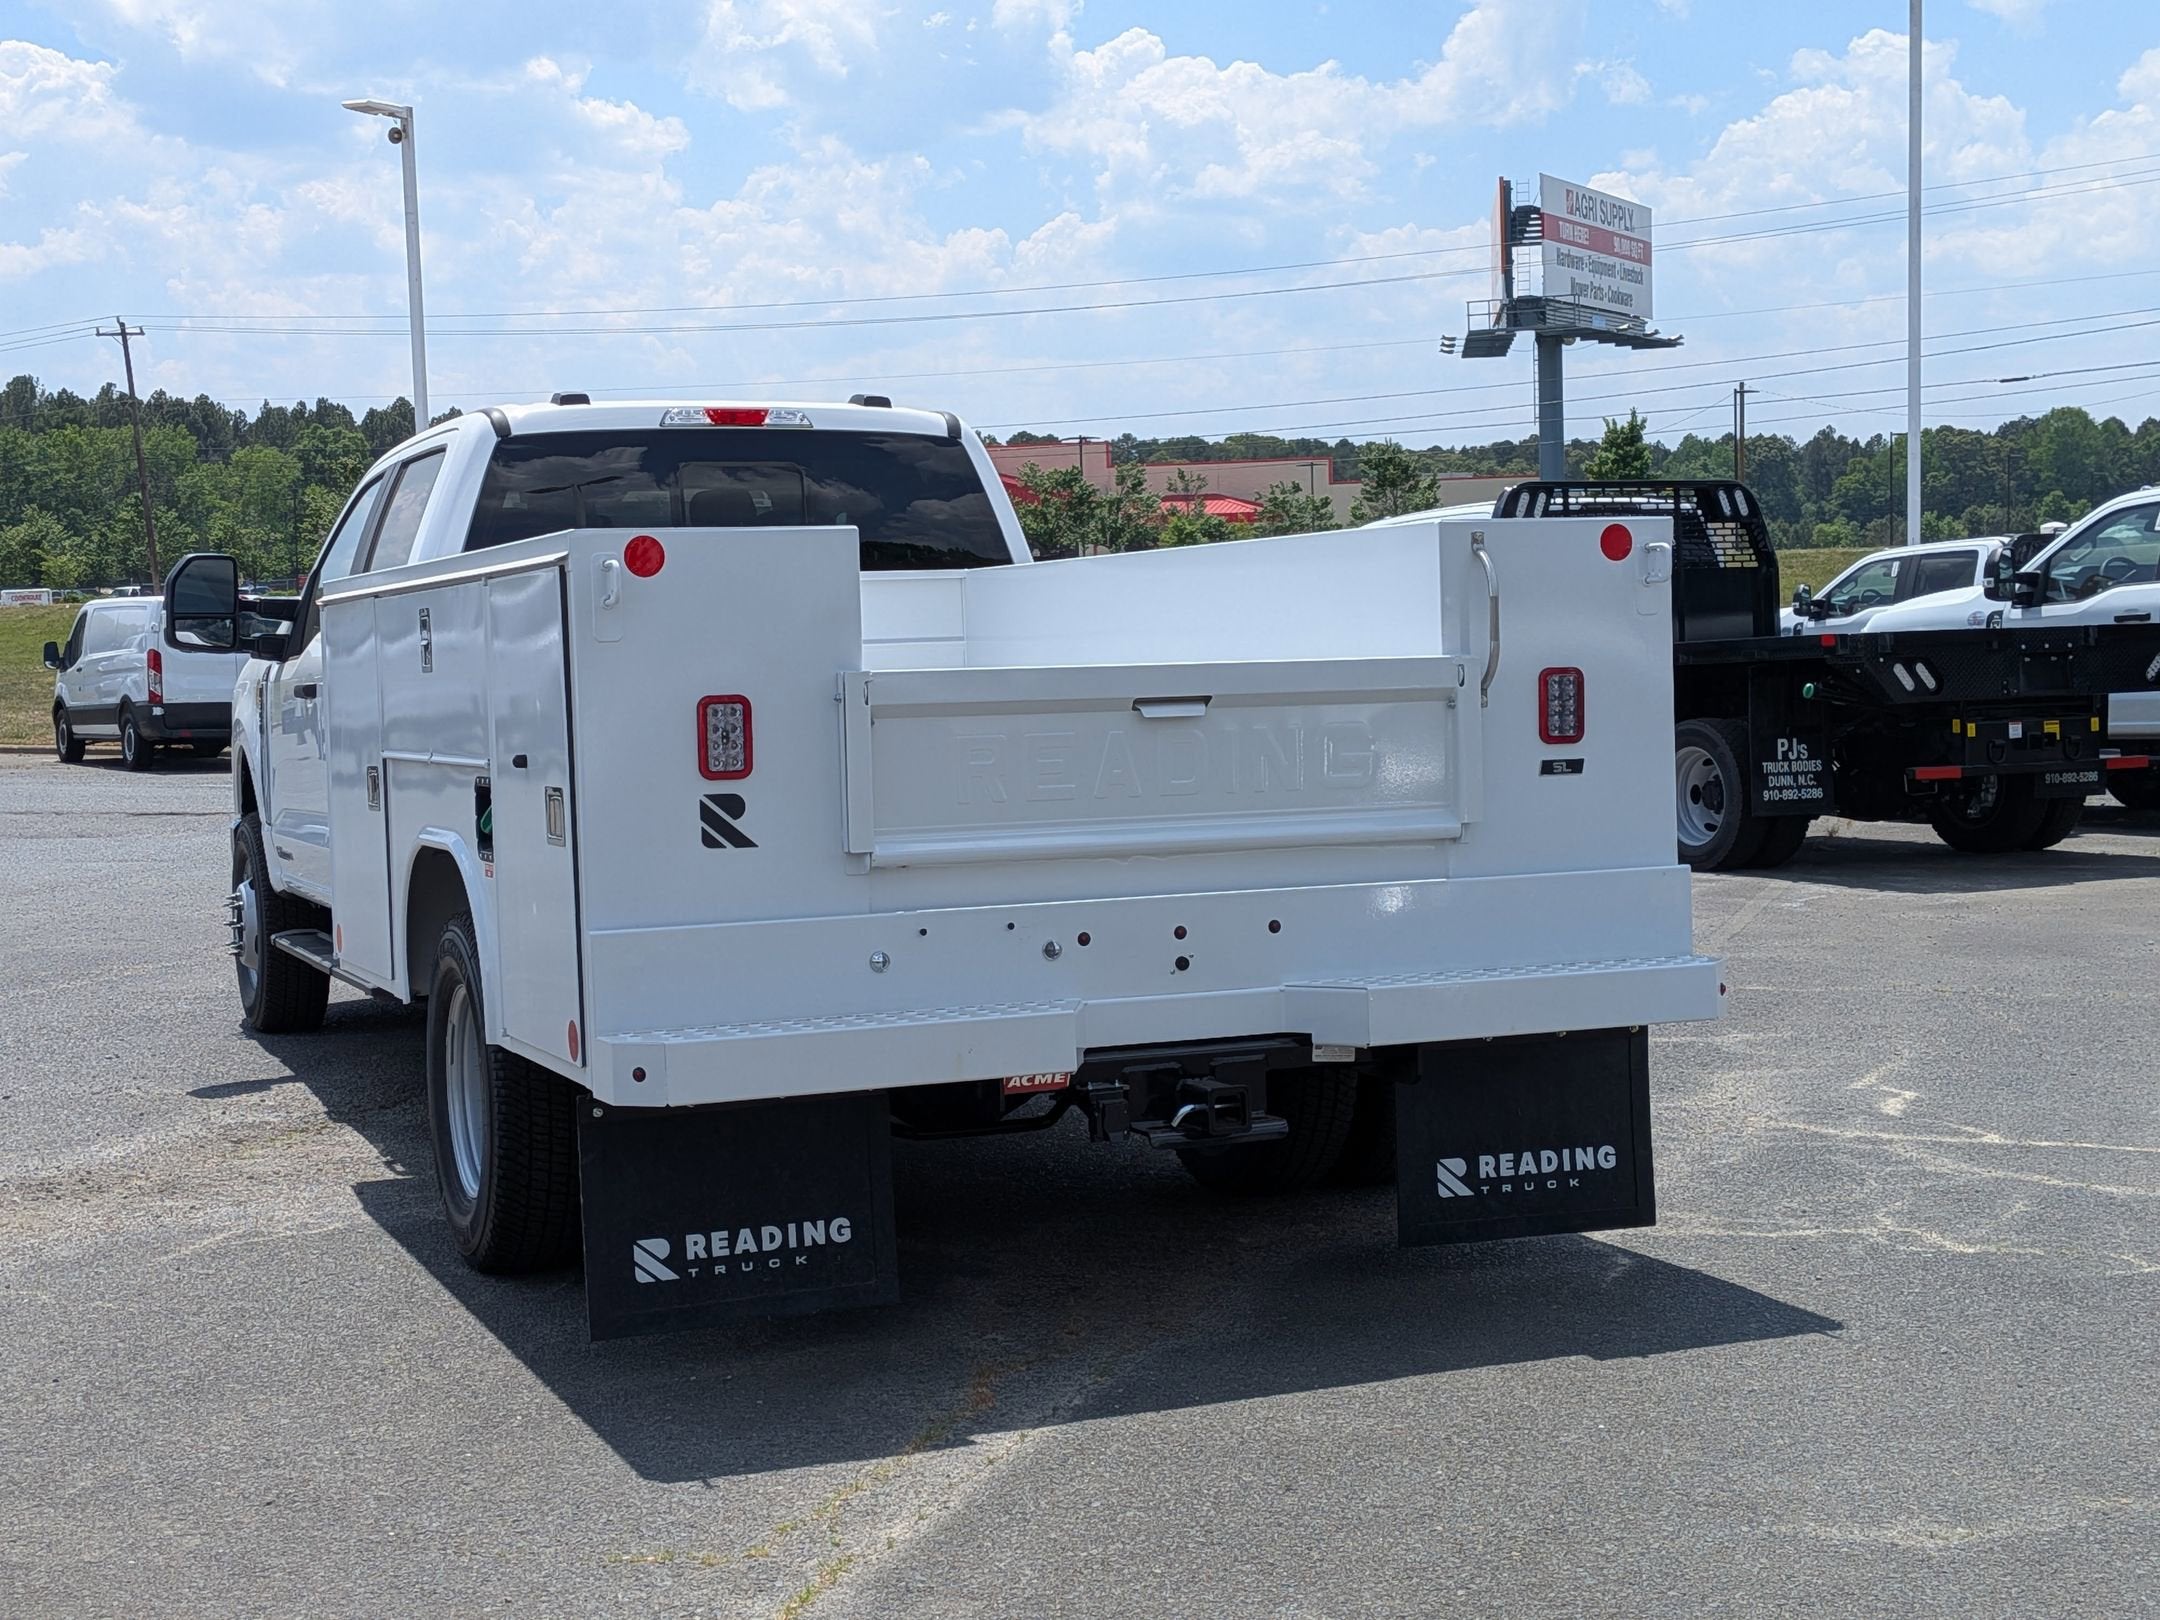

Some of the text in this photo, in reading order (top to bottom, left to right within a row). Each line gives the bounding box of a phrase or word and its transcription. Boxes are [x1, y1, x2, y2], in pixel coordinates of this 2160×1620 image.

[1574, 192, 1634, 232] AGRI SUPPLY
[953, 721, 1375, 805] READING
[1762, 759, 1823, 774] TRUCK BODIES
[1768, 775, 1797, 788] DUNN,
[2044, 770, 2099, 784] 910-892-5286
[1763, 787, 1824, 801] 910-892-5286
[1007, 1072, 1066, 1088] ACME
[1478, 1145, 1617, 1179] READING
[1480, 1178, 1580, 1194] TRUCK
[685, 1217, 852, 1261] READING
[688, 1255, 808, 1278] TRUCK
